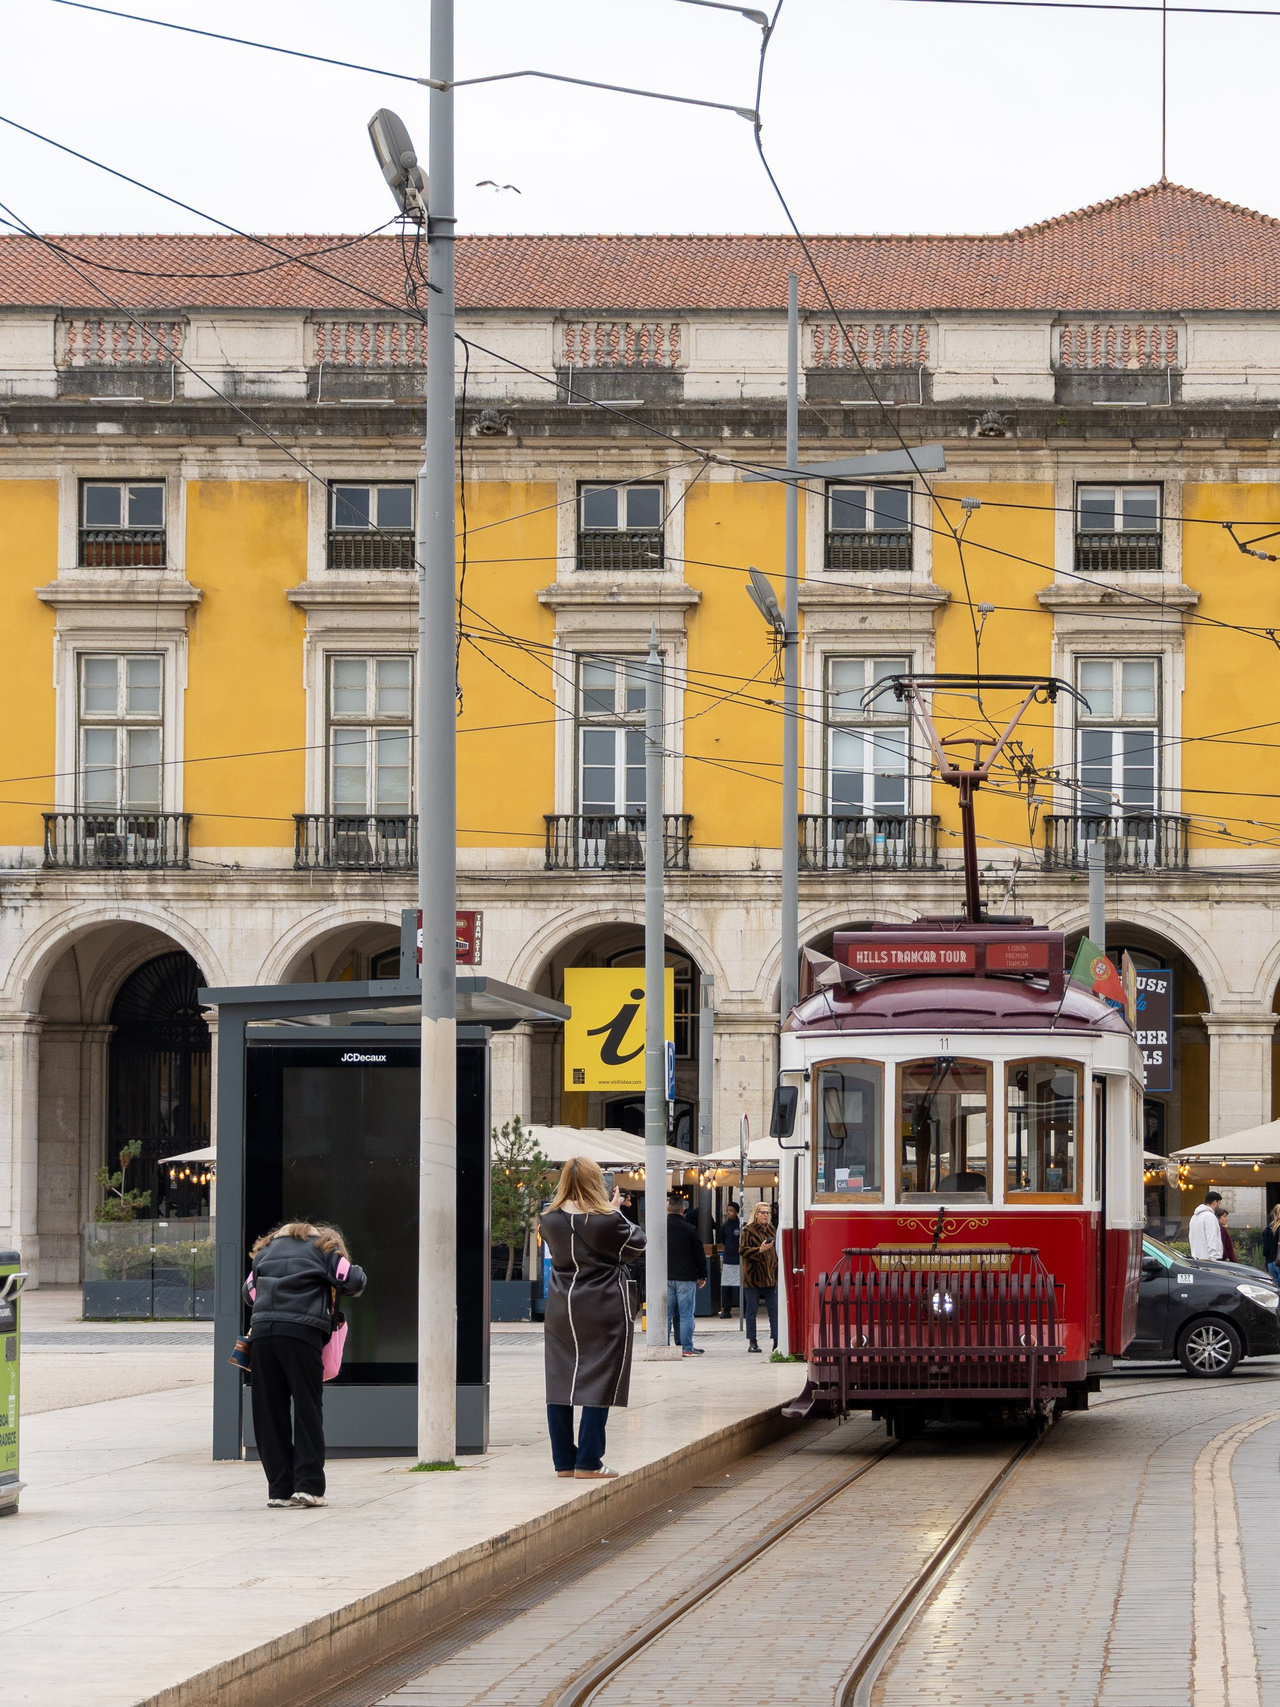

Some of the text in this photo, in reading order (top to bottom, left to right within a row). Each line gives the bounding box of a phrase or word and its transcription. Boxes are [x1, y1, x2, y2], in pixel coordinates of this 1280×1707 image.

[856, 950, 967, 963] HILLS TRAMCAR TOUR
[1136, 977, 1167, 994] USE
[939, 1038, 949, 1050] 11
[341, 1053, 387, 1062] JCDecaux
